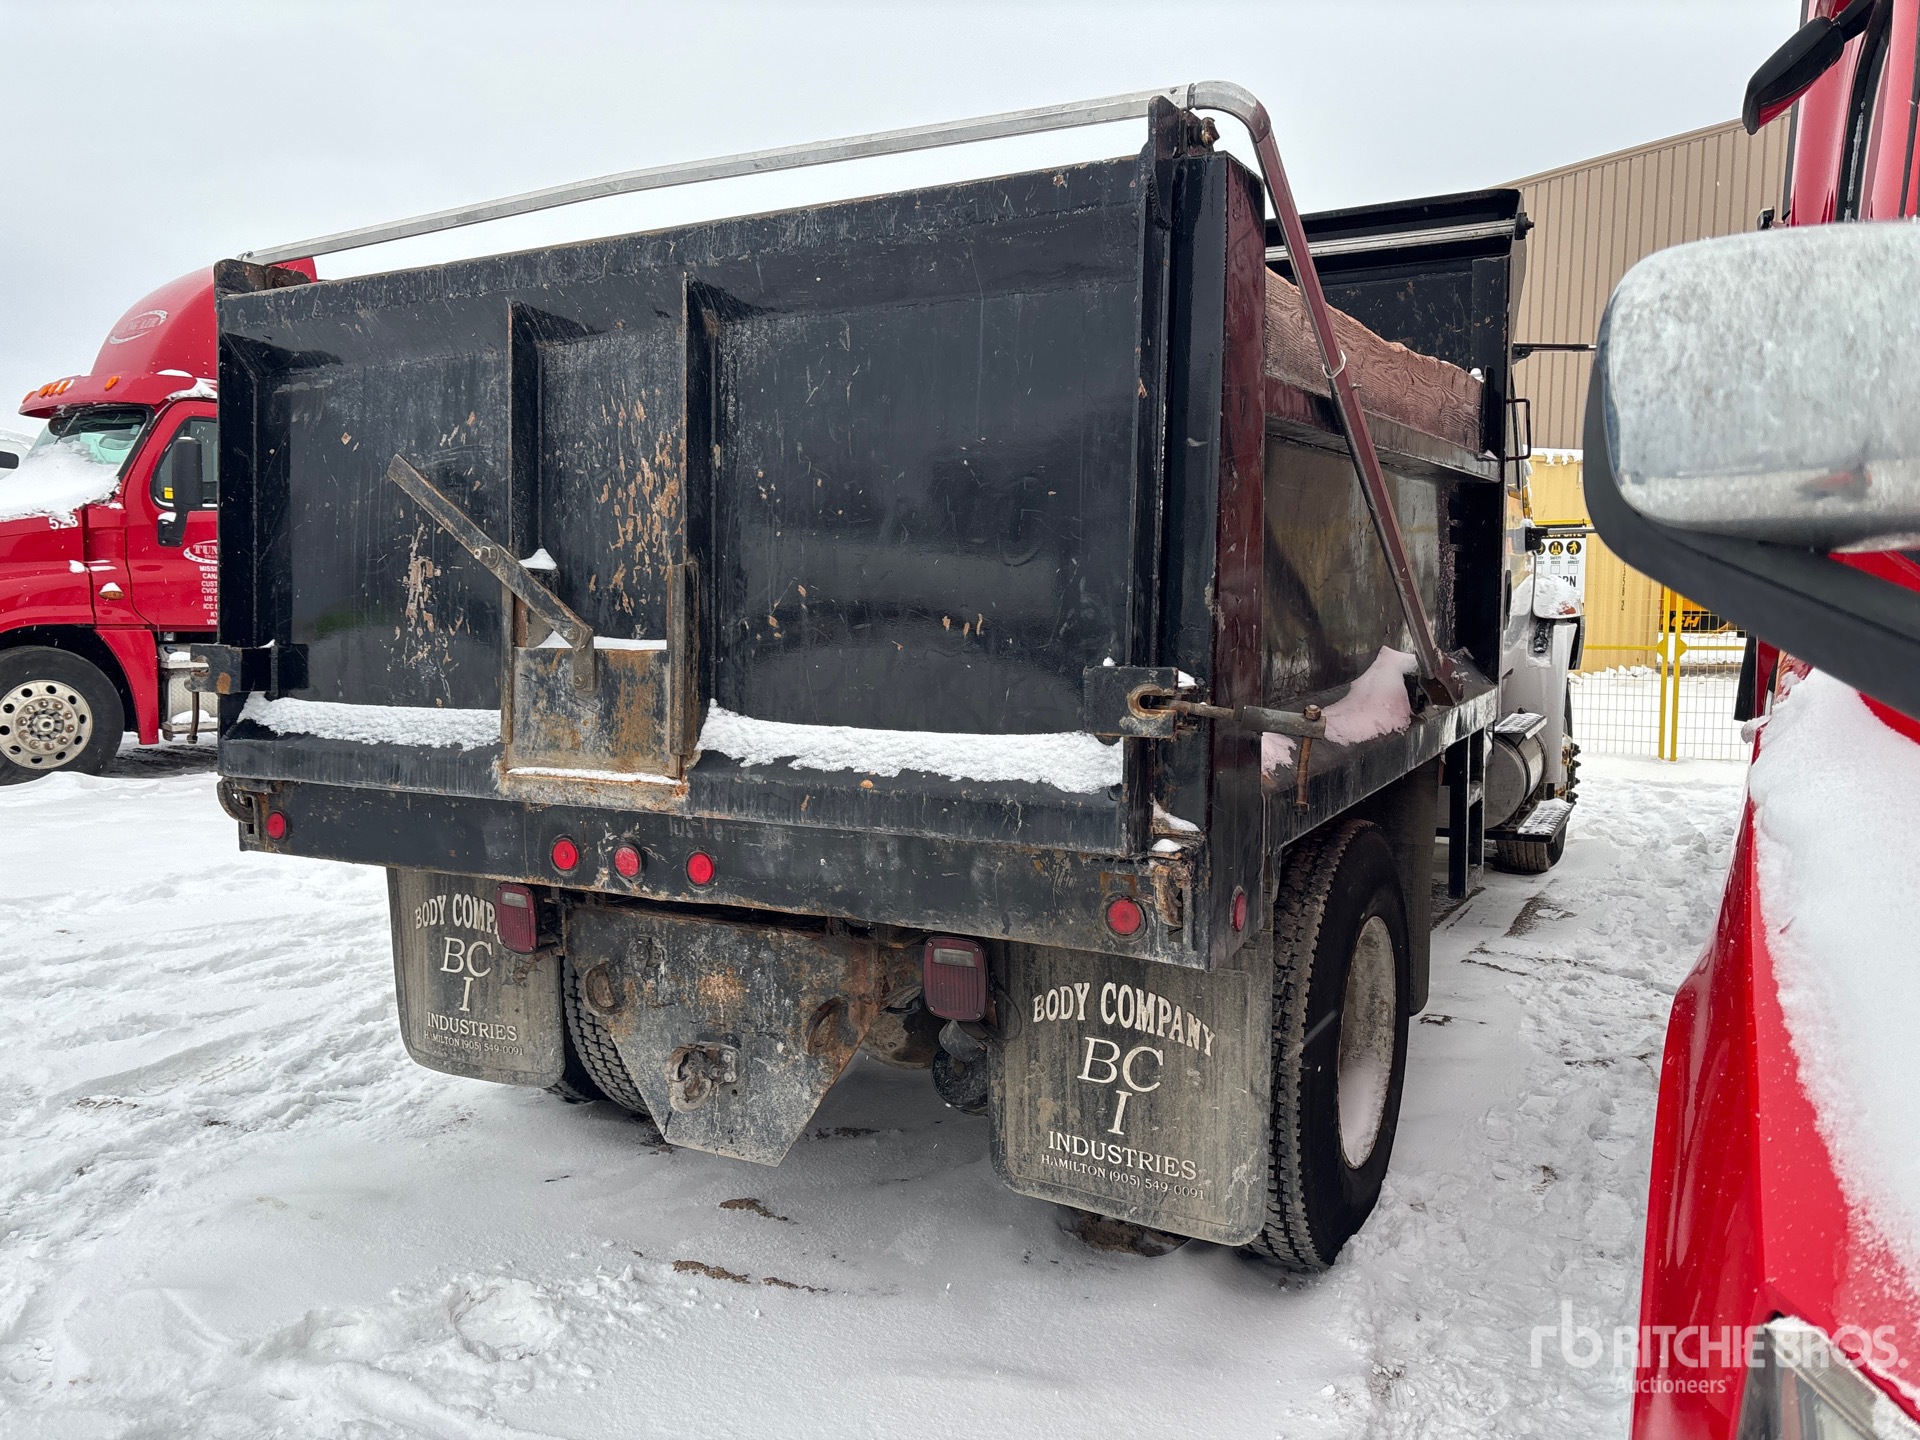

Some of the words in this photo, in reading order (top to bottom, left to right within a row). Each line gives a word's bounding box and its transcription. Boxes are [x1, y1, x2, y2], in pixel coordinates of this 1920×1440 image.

[415, 895, 447, 930] BODY
[453, 893, 503, 945] COMP
[440, 937, 492, 977] BC
[427, 1012, 518, 1041] INDUSTRIES
[1033, 982, 1090, 1023] BODY
[1101, 982, 1215, 1057] COMPANY
[1077, 1036, 1163, 1092] BC
[1041, 1154, 1106, 1179] HAMILTON
[1109, 1170, 1141, 1189] (905)
[1145, 1177, 1205, 1199] 549-0091
[1049, 1130, 1197, 1180] INDUSTRIES
